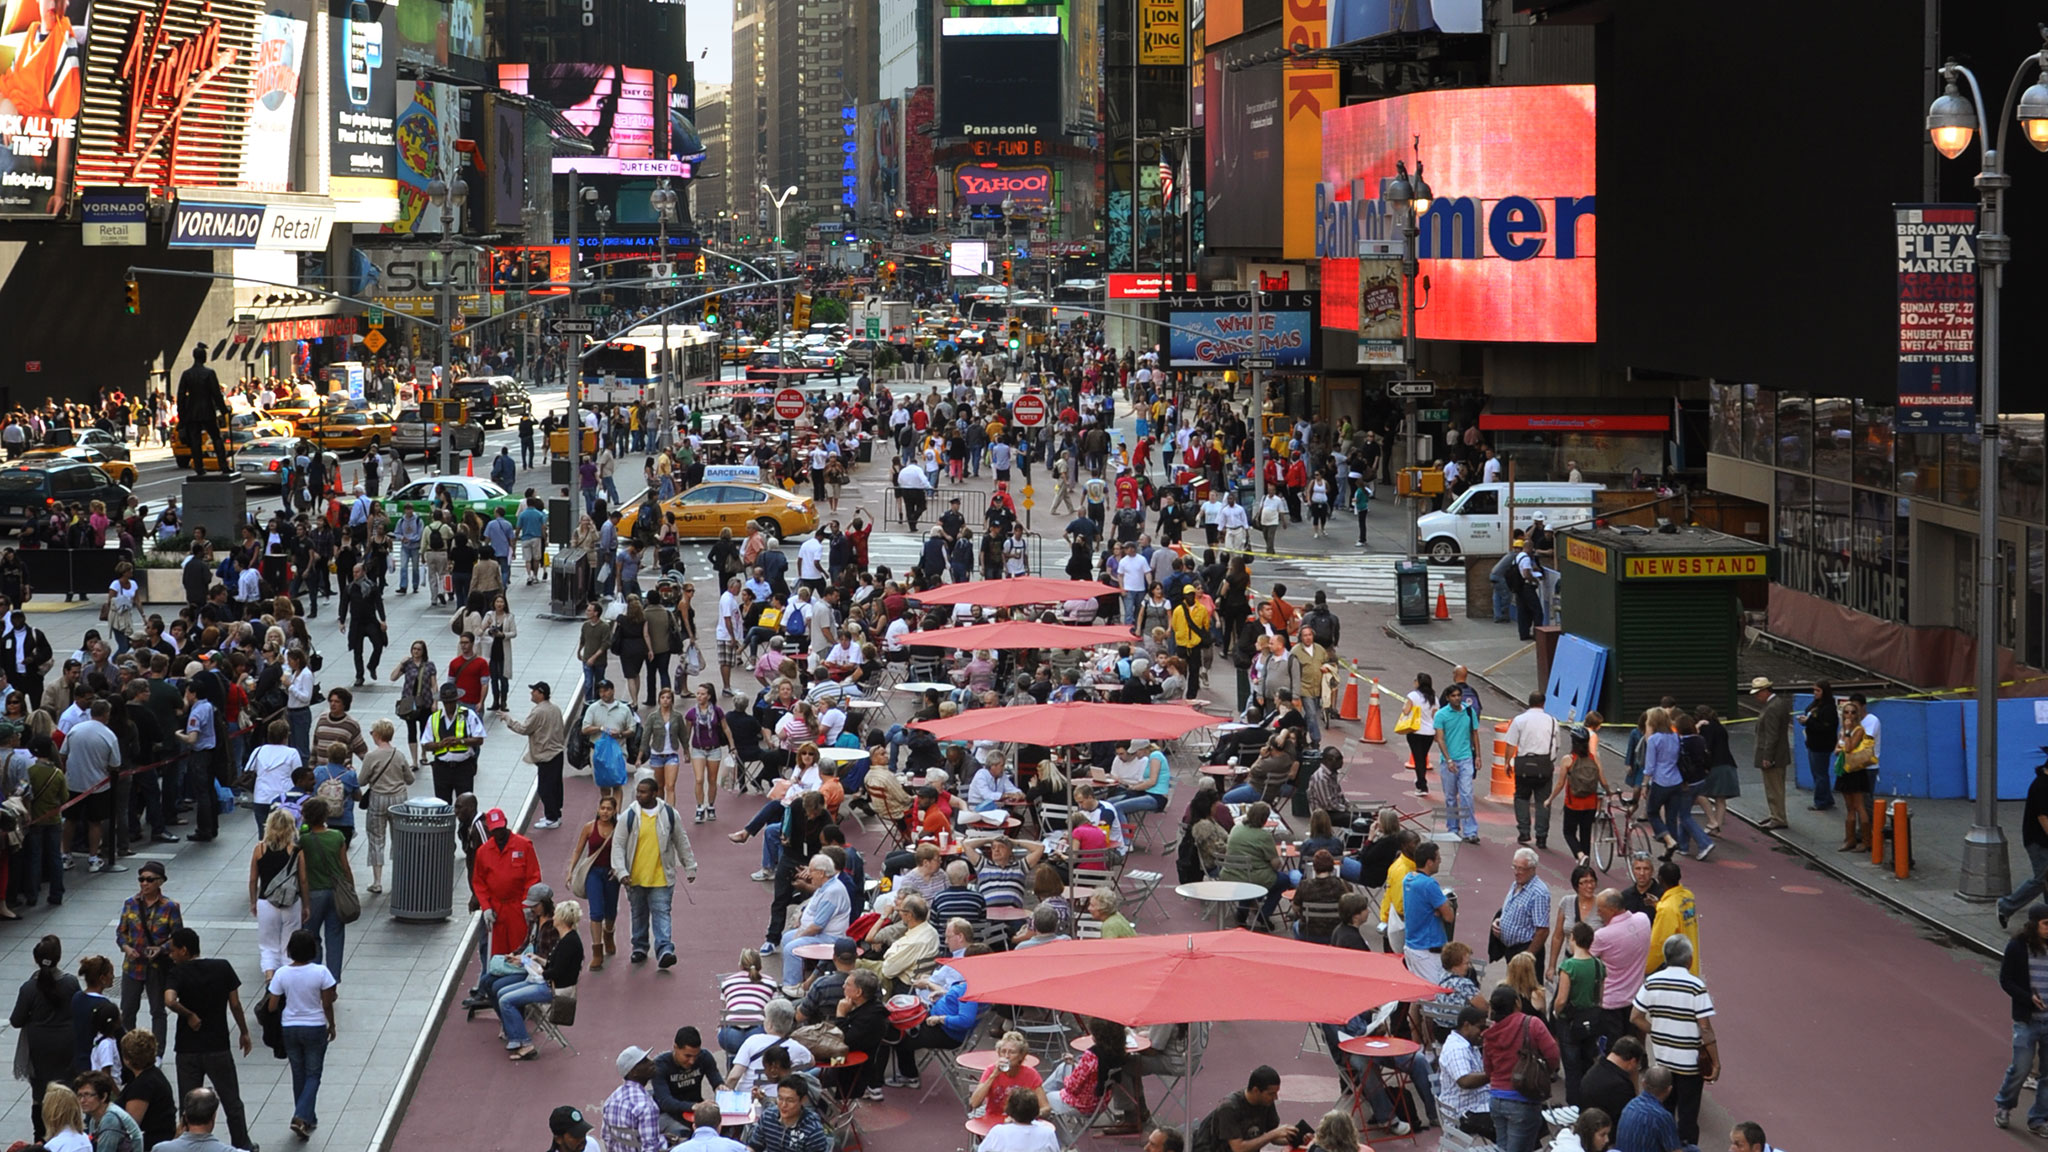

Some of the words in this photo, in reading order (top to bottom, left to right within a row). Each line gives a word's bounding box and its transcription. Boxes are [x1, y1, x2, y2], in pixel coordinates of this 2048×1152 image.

[1144, 8, 1178, 28] LION
[1144, 32, 1180, 52] KING
[24, 116, 49, 136] ALL
[51, 118, 77, 138] THE
[964, 124, 1037, 135] Panasonic
[12, 136, 52, 157] TIME?
[960, 175, 1048, 194] YAHOO!
[83, 203, 145, 212] VORNADO
[176, 211, 260, 238] VORNADO
[1315, 179, 1366, 259] Bank
[100, 225, 129, 235] Retail
[271, 215, 322, 240] Retail
[1897, 224, 1975, 236] BROADWAY
[1898, 235, 1976, 259] FLEA
[1899, 259, 1976, 273] MARKET
[1901, 287, 1975, 299] AUCTION
[1170, 294, 1313, 309] MARQUIS
[1900, 303, 1937, 314] SUNDAY,
[1939, 303, 1962, 313] SEPT.
[1963, 303, 1974, 313] 27
[295, 317, 358, 340] HOLLYWOOD
[1900, 329, 1943, 340] SHUBERT
[1944, 329, 1974, 340] ALLEY
[1906, 341, 1926, 351] WEST
[1944, 341, 1974, 351] STREET
[1395, 385, 1409, 393] ONE
[1414, 385, 1429, 393] WAY
[706, 469, 755, 477] BARCELONA
[1569, 540, 1604, 567] NEWSSTAND
[1634, 557, 1756, 575] NEWSSTAND
